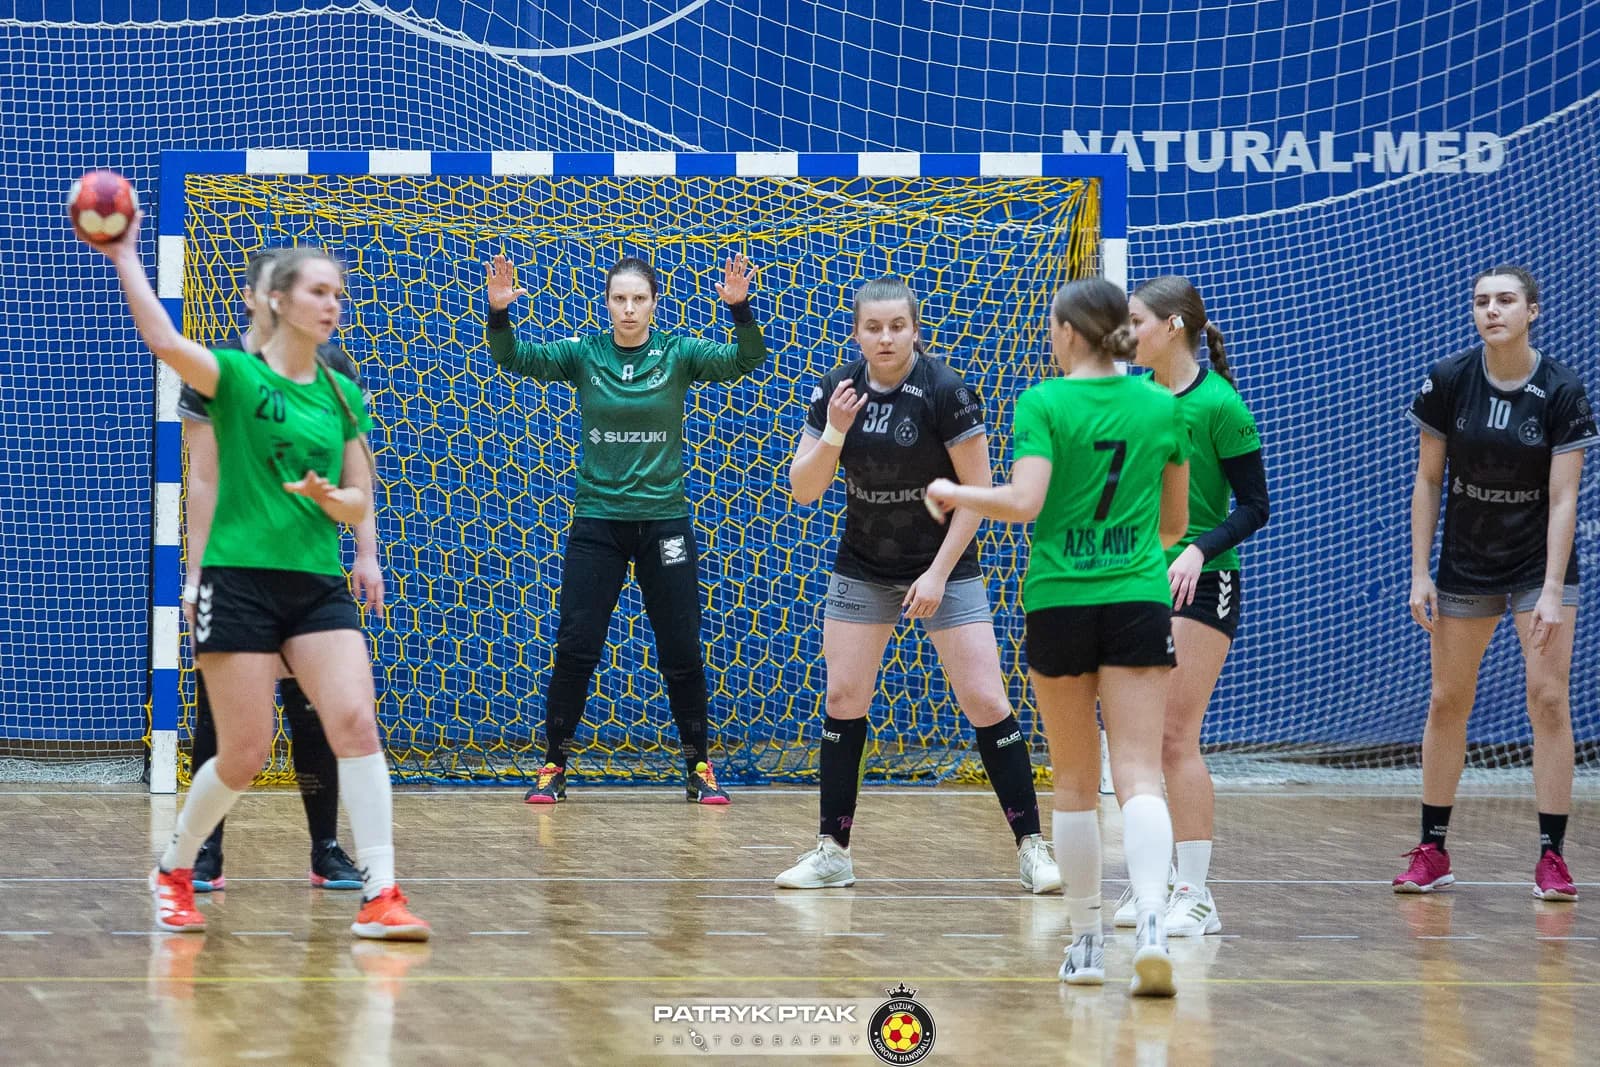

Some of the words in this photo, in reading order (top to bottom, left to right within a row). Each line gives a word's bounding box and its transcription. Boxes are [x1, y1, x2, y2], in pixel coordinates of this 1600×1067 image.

[1062, 129, 1506, 174] NATURAL-MED
[256, 385, 285, 422] 20
[862, 401, 893, 434] 32
[1487, 396, 1512, 430] 10
[604, 431, 667, 443] SUZUKI
[856, 487, 927, 505] SUZUKI
[1093, 439, 1128, 521] 7
[1467, 484, 1540, 503] SUZUKI
[1064, 528, 1096, 557] AZS
[1102, 526, 1138, 555] AWF
